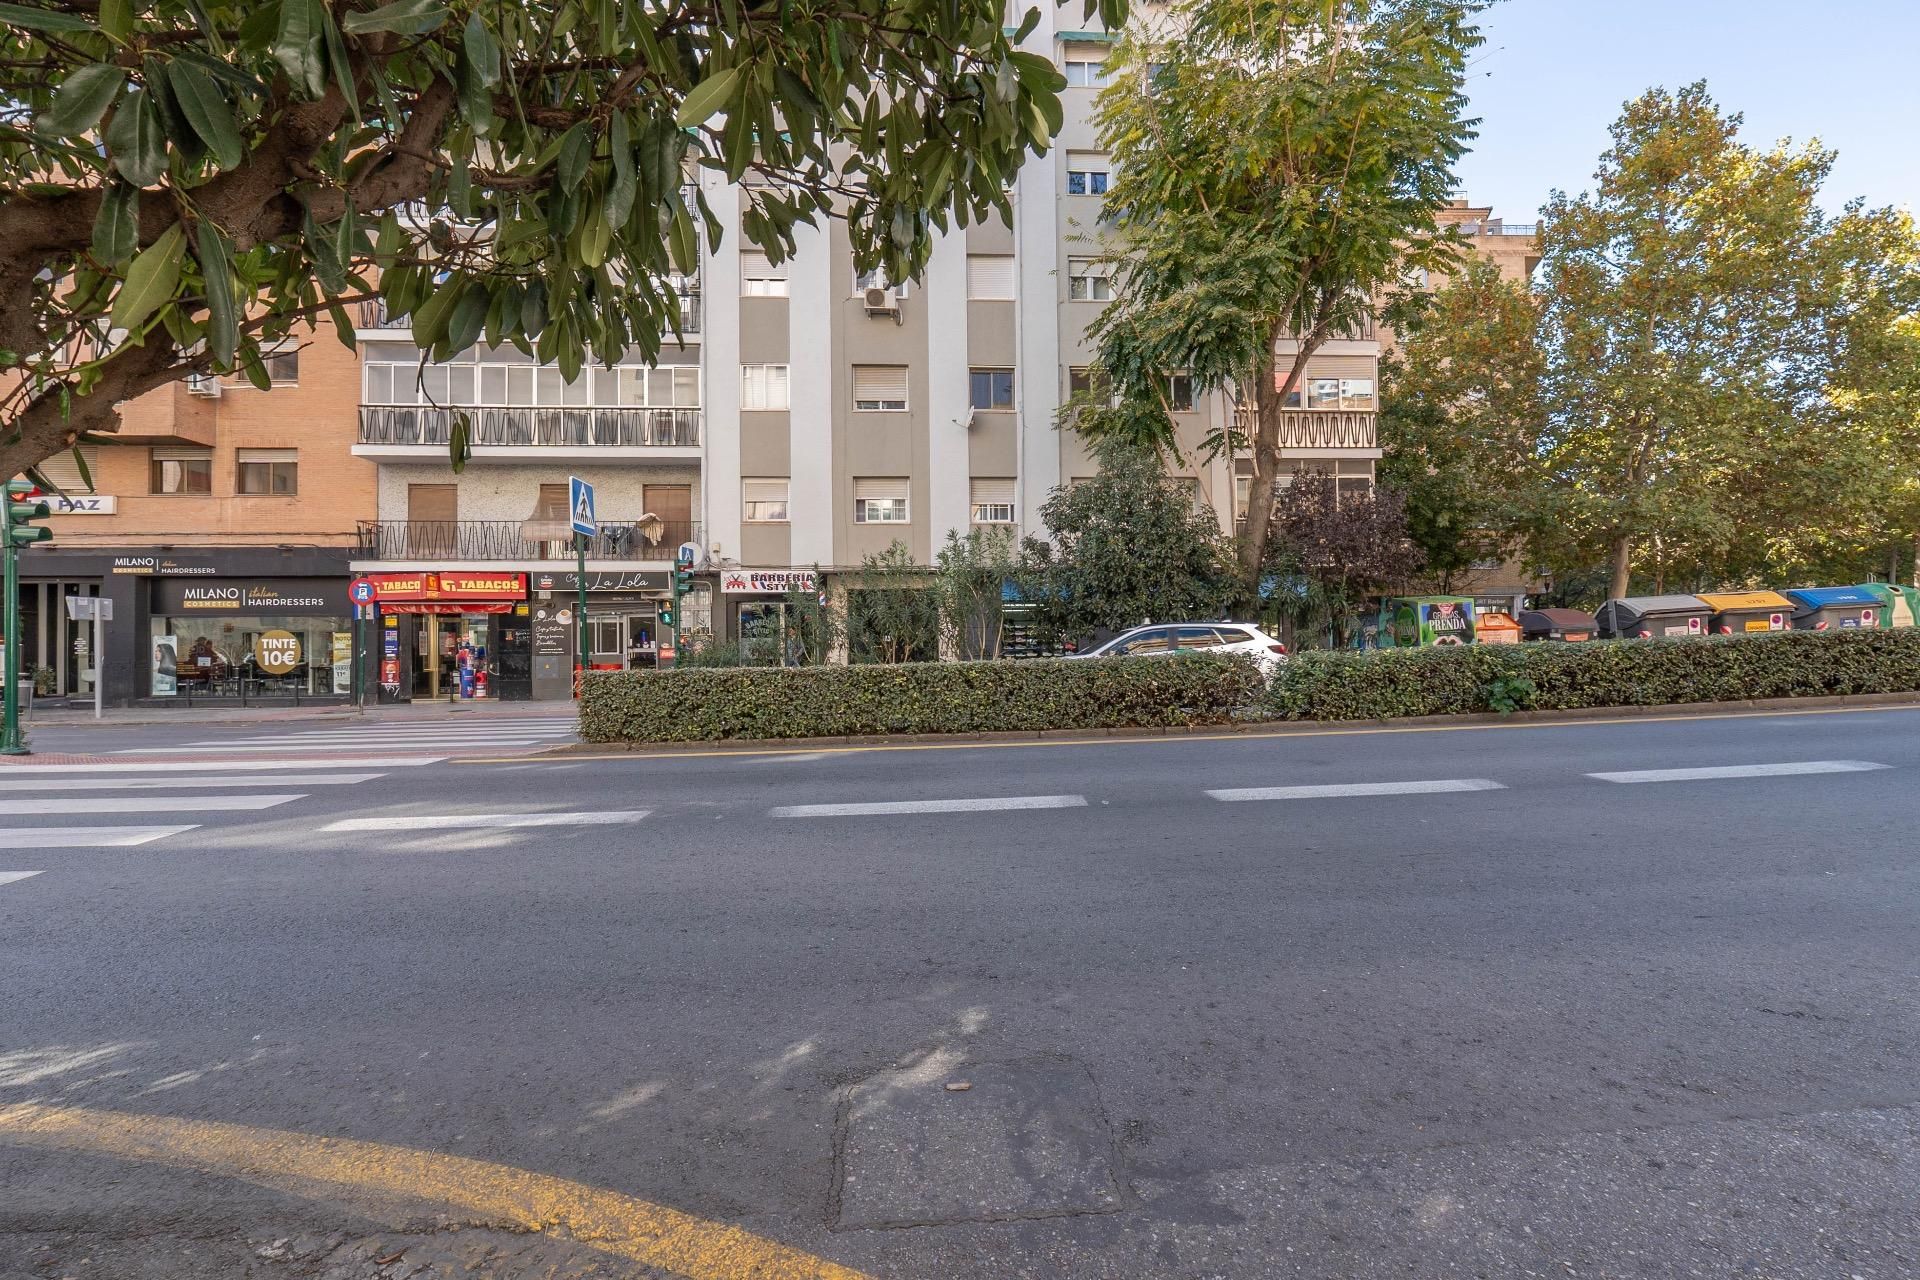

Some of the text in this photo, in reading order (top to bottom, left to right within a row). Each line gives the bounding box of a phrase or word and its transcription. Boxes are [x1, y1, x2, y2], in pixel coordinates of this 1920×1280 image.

[58, 500, 100, 510] PAZ
[114, 557, 154, 566] MILANO
[383, 581, 421, 590] TABACO
[459, 580, 520, 589] TABACOS
[590, 571, 649, 590] La Lola
[184, 588, 239, 599] MILANO
[248, 586, 279, 598] italian
[248, 598, 324, 606] HAIRDRESSERS
[1429, 618, 1466, 631] PRENDA
[262, 638, 297, 649] TINTE
[262, 650, 295, 666] 10€
